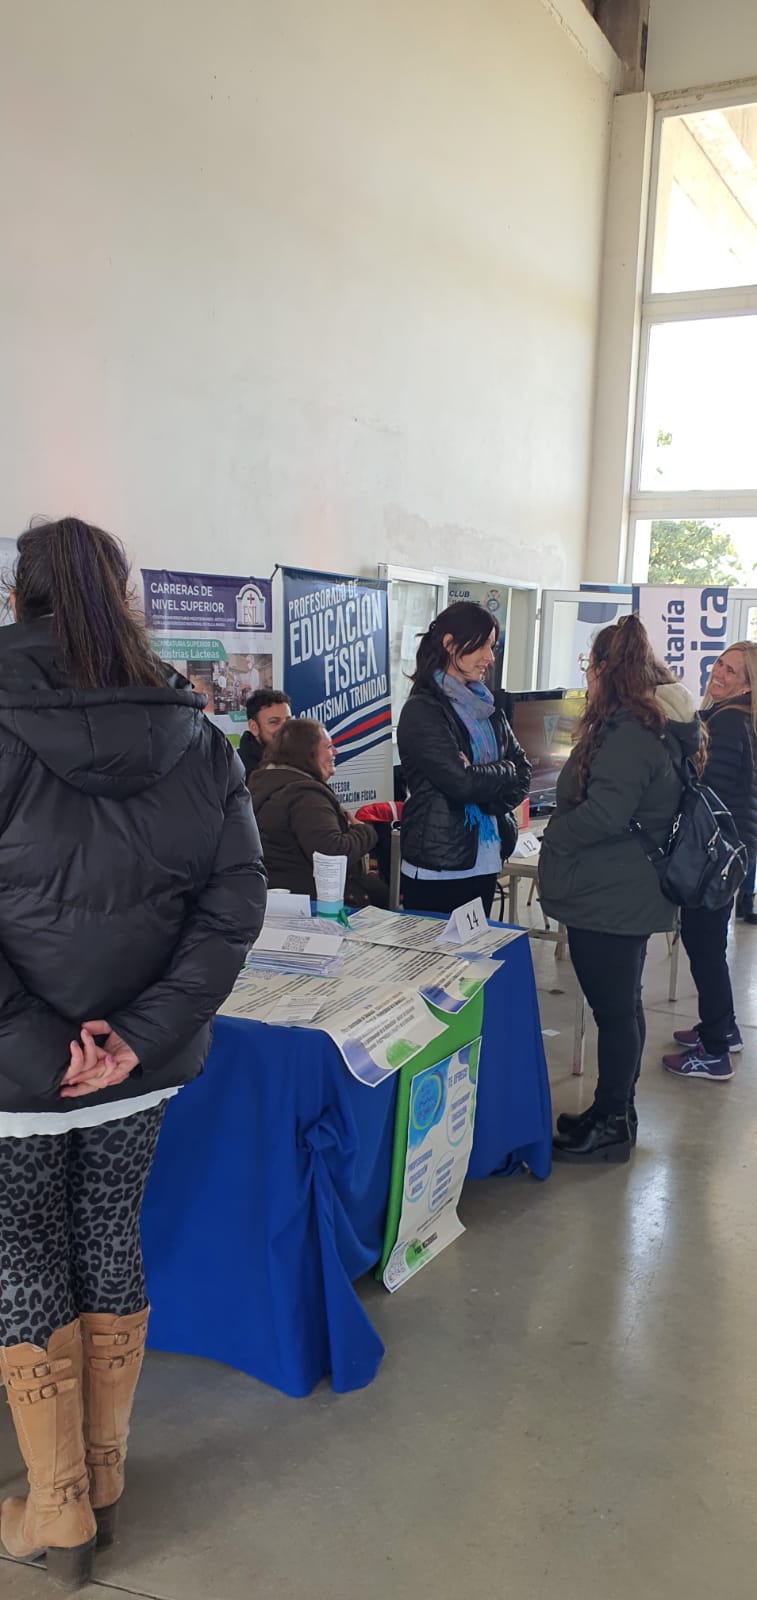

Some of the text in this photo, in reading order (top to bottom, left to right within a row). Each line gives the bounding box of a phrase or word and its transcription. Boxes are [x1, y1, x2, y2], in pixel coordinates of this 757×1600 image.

[150, 582, 213, 597] CARRERAS DE
[449, 590, 470, 598] CLUB
[151, 599, 225, 613] NIVEL SUPERIOR
[288, 578, 360, 621] PROFESORADO DE
[289, 590, 383, 666] EDUCACIÓN
[157, 648, 189, 659] dustrias
[324, 636, 378, 697] FÍSICA
[349, 674, 388, 709] TRINIDAD
[523, 839, 537, 852] 12
[466, 909, 480, 931] 14
